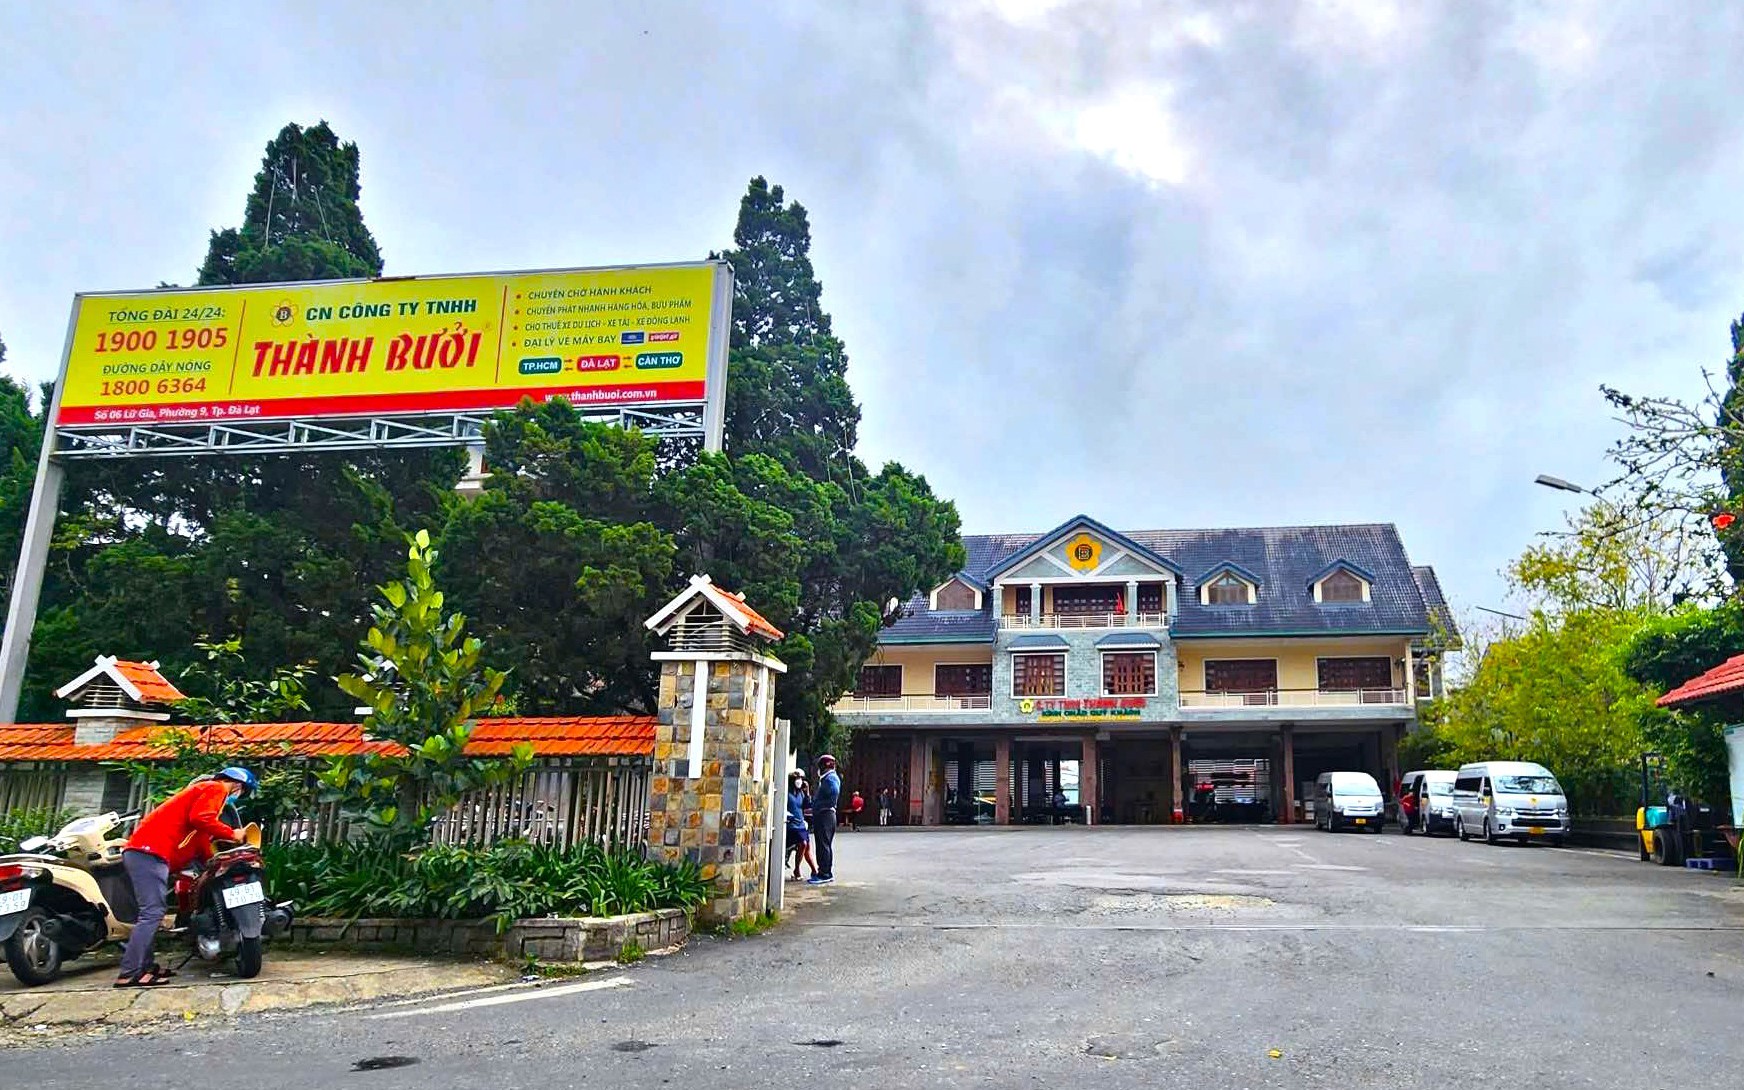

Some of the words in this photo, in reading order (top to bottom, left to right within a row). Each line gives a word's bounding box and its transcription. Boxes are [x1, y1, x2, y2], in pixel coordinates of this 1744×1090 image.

[109, 306, 149, 322] TỔNG
[153, 305, 179, 320] ĐÀI
[183, 307, 226, 321] 24/24:
[306, 306, 332, 321] CN
[339, 301, 391, 319] CÔNG
[399, 302, 419, 316] TY
[427, 299, 477, 315] TNHH
[562, 320, 571, 329] XE
[573, 320, 583, 328] DU
[607, 319, 617, 327] XE
[637, 317, 645, 325] XE
[94, 330, 157, 353] 1900
[166, 327, 228, 350] 1905
[524, 338, 541, 349] ĐẠI
[545, 336, 554, 346] LÝ
[572, 335, 595, 345] MÁY
[597, 335, 617, 344] BAY
[252, 332, 374, 377] THÀNH
[385, 321, 482, 372] BƯỞI
[103, 361, 147, 374] ĐƯỜNG
[523, 361, 558, 371] TP.HCM
[580, 358, 595, 368] ĐÀ
[597, 357, 616, 369] LẠT
[638, 354, 657, 365] CẦN
[660, 354, 680, 364] THƠ
[101, 380, 150, 396] 1800
[157, 377, 207, 394] 6364
[109, 411, 122, 419] 06
[212, 406, 226, 416] Tp.
[228, 405, 242, 414] Đà
